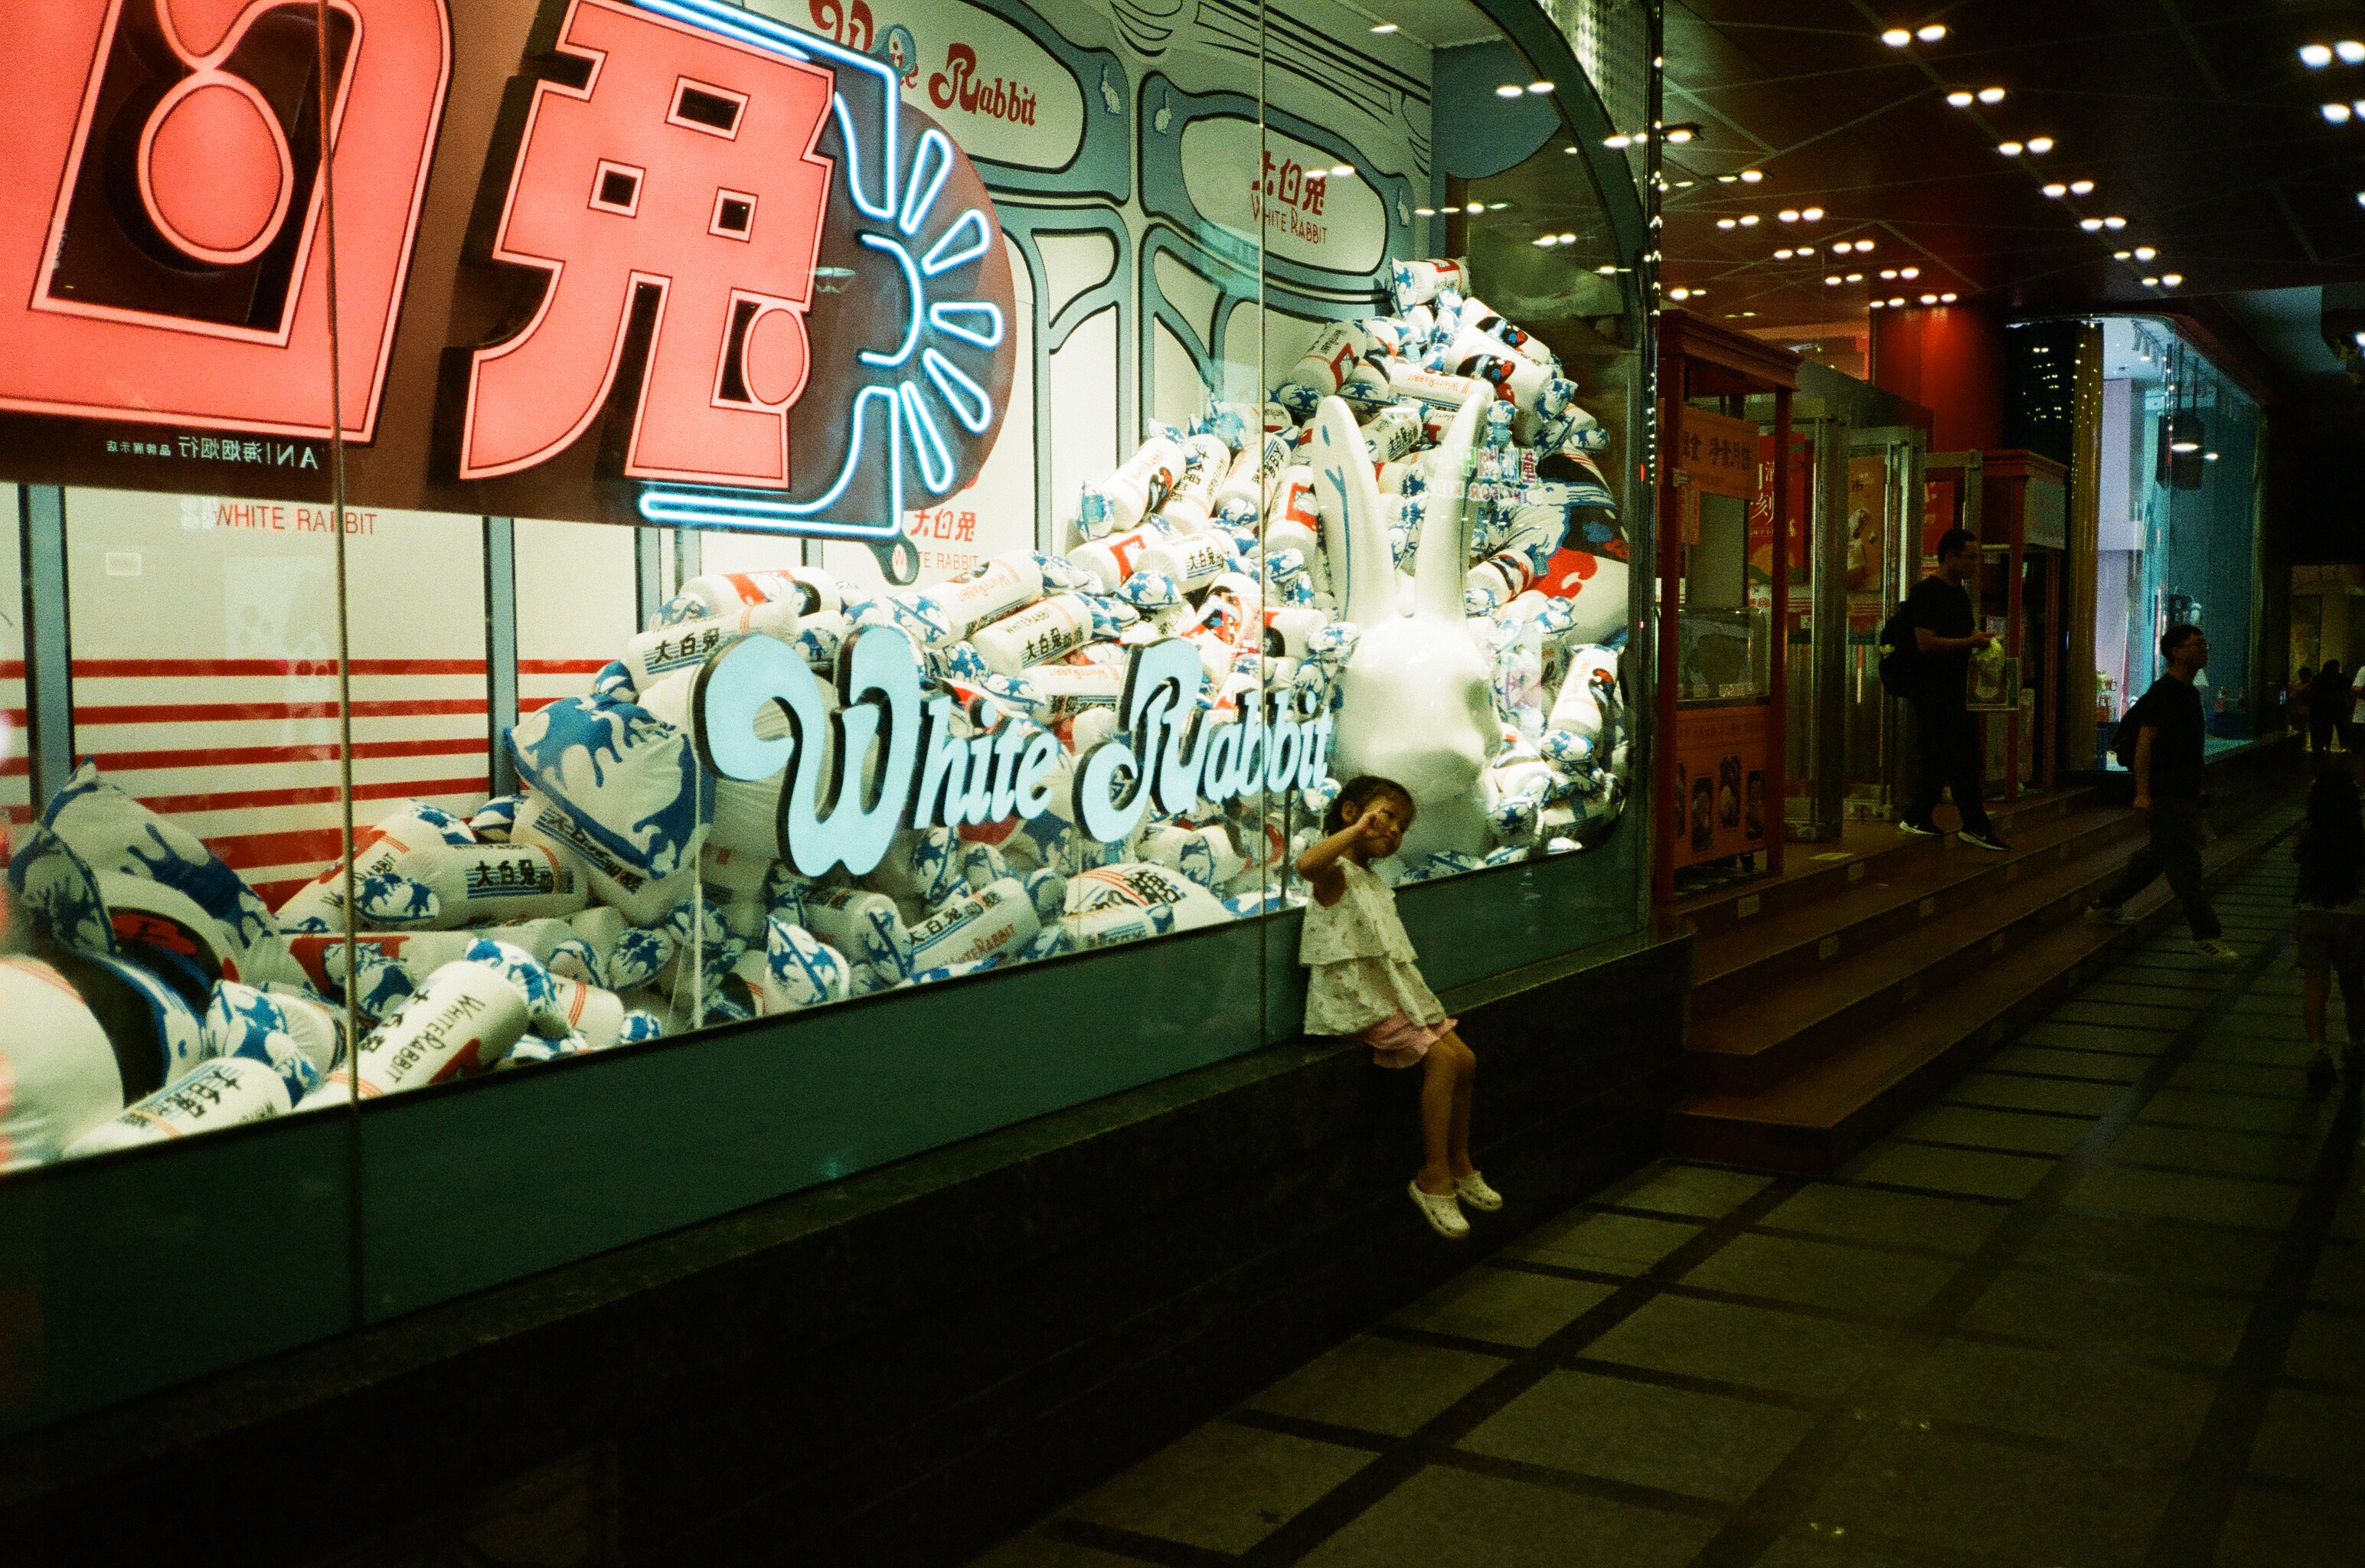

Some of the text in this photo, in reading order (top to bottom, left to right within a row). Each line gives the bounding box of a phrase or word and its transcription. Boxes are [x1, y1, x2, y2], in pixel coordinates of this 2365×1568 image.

[928, 43, 1037, 126] Rabbit
[1291, 207, 1327, 243] RABBIT
[215, 502, 285, 530] WHITE
[297, 508, 377, 535] RABIT
[910, 508, 976, 541] 大白兔
[893, 550, 978, 570] WTE RABBIT
[697, 624, 1334, 877] White Rabbit
